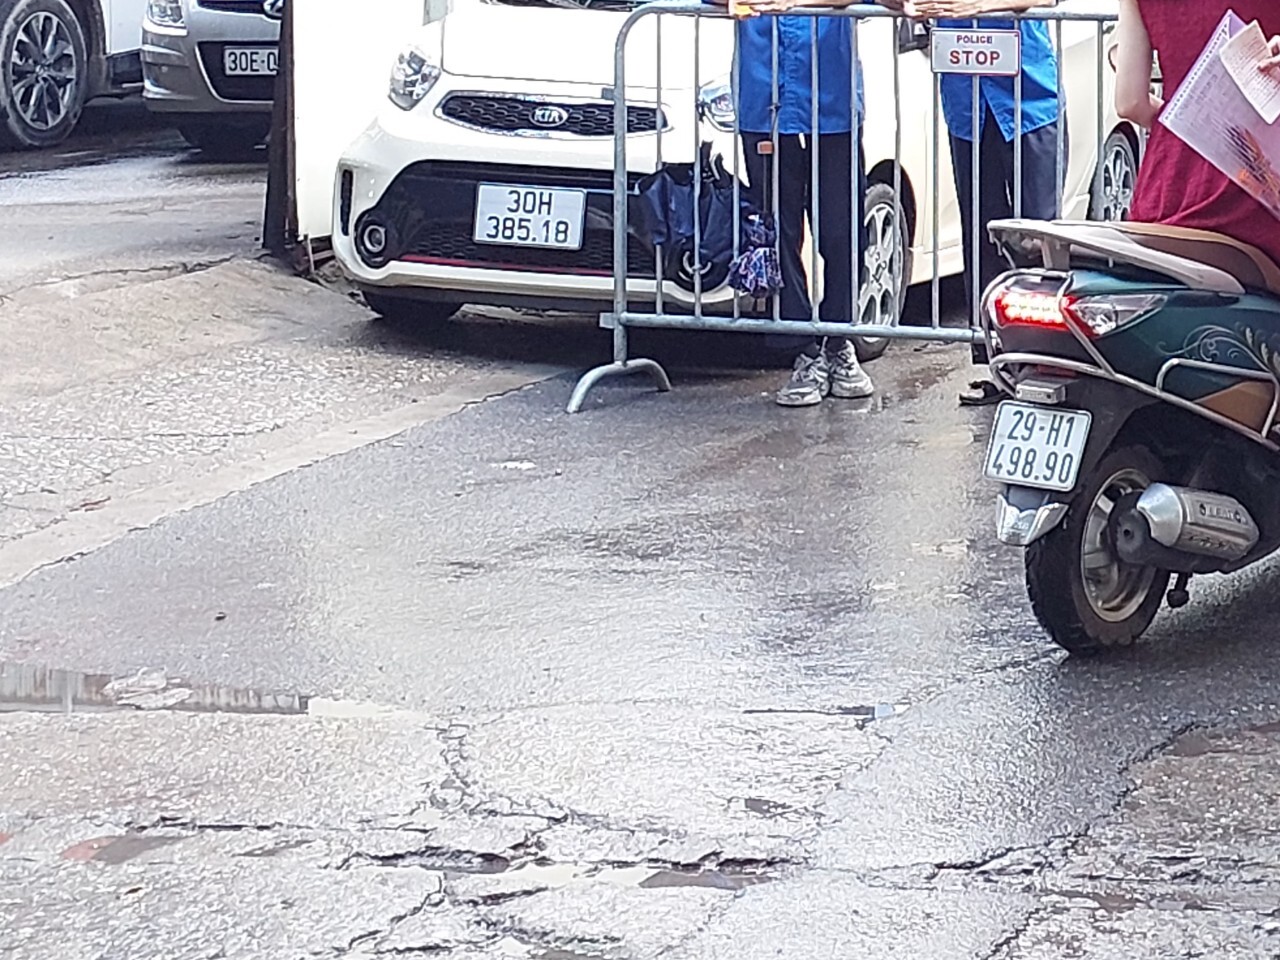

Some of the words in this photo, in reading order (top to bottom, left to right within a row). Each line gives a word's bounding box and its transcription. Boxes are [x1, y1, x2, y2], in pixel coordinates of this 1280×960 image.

[956, 34, 993, 44] POLICE
[228, 51, 278, 72] 30E-0
[949, 49, 1001, 66] STOP
[534, 108, 560, 123] KIA
[507, 190, 553, 215] 30H
[485, 216, 569, 244] 385.18
[1006, 410, 1076, 448] 29-H1
[992, 443, 1074, 484] 498.90
